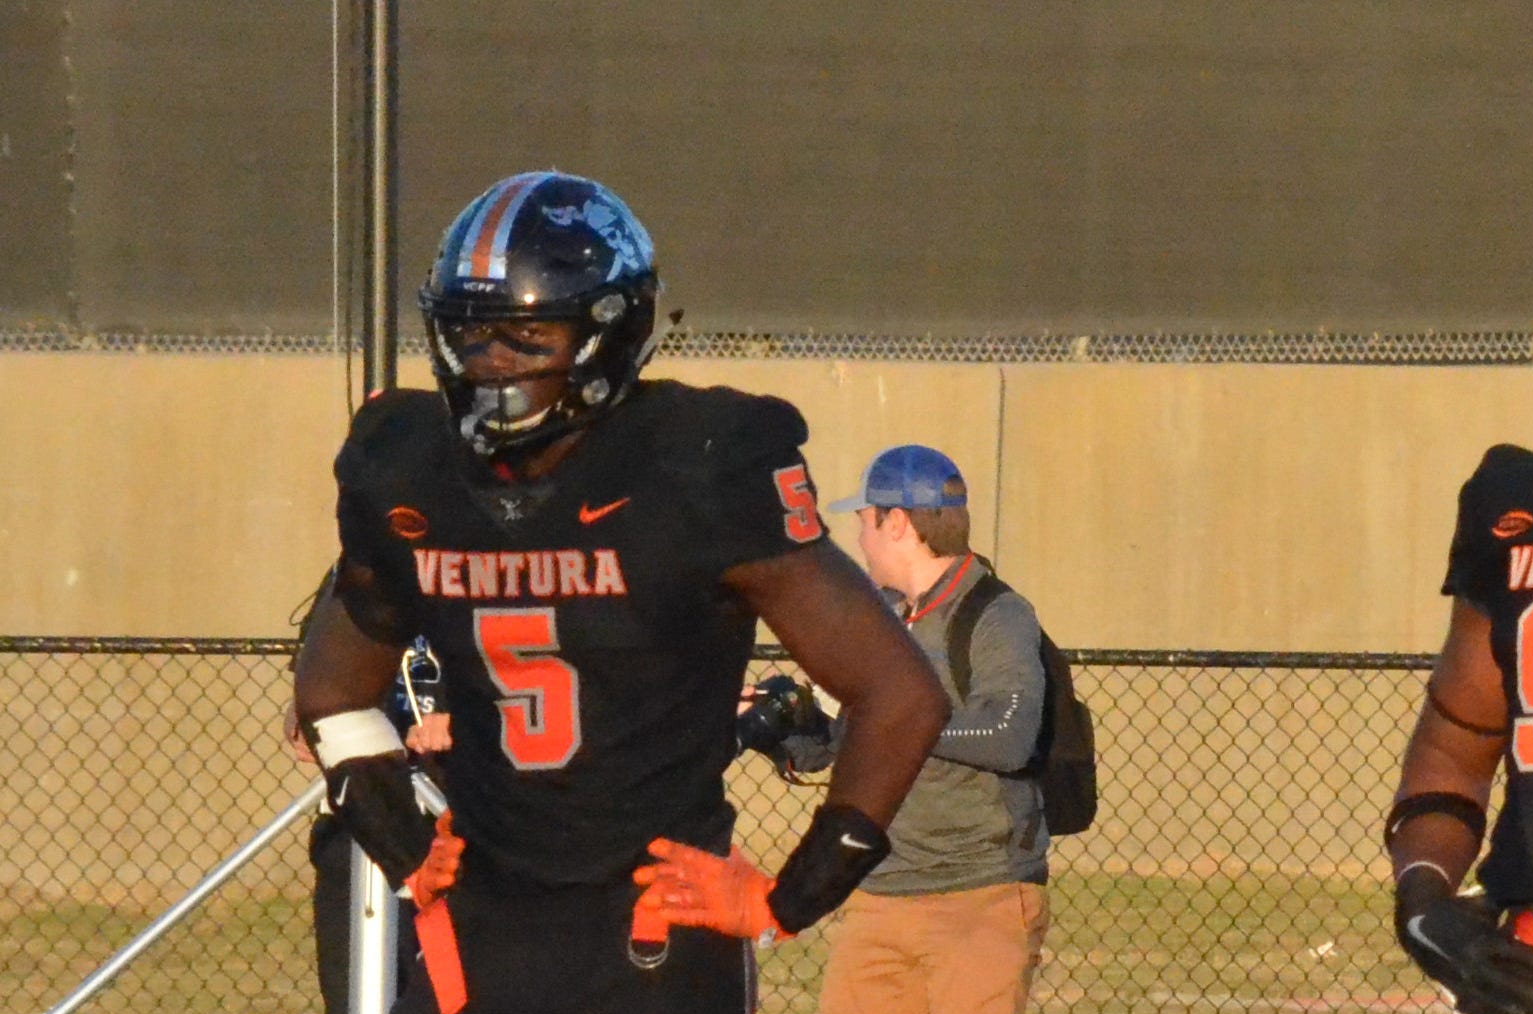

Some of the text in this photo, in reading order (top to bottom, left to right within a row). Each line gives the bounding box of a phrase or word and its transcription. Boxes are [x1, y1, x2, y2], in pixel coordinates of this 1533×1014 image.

[773, 463, 822, 543] 5
[413, 548, 628, 597] VENTURA
[473, 607, 582, 771] 5
